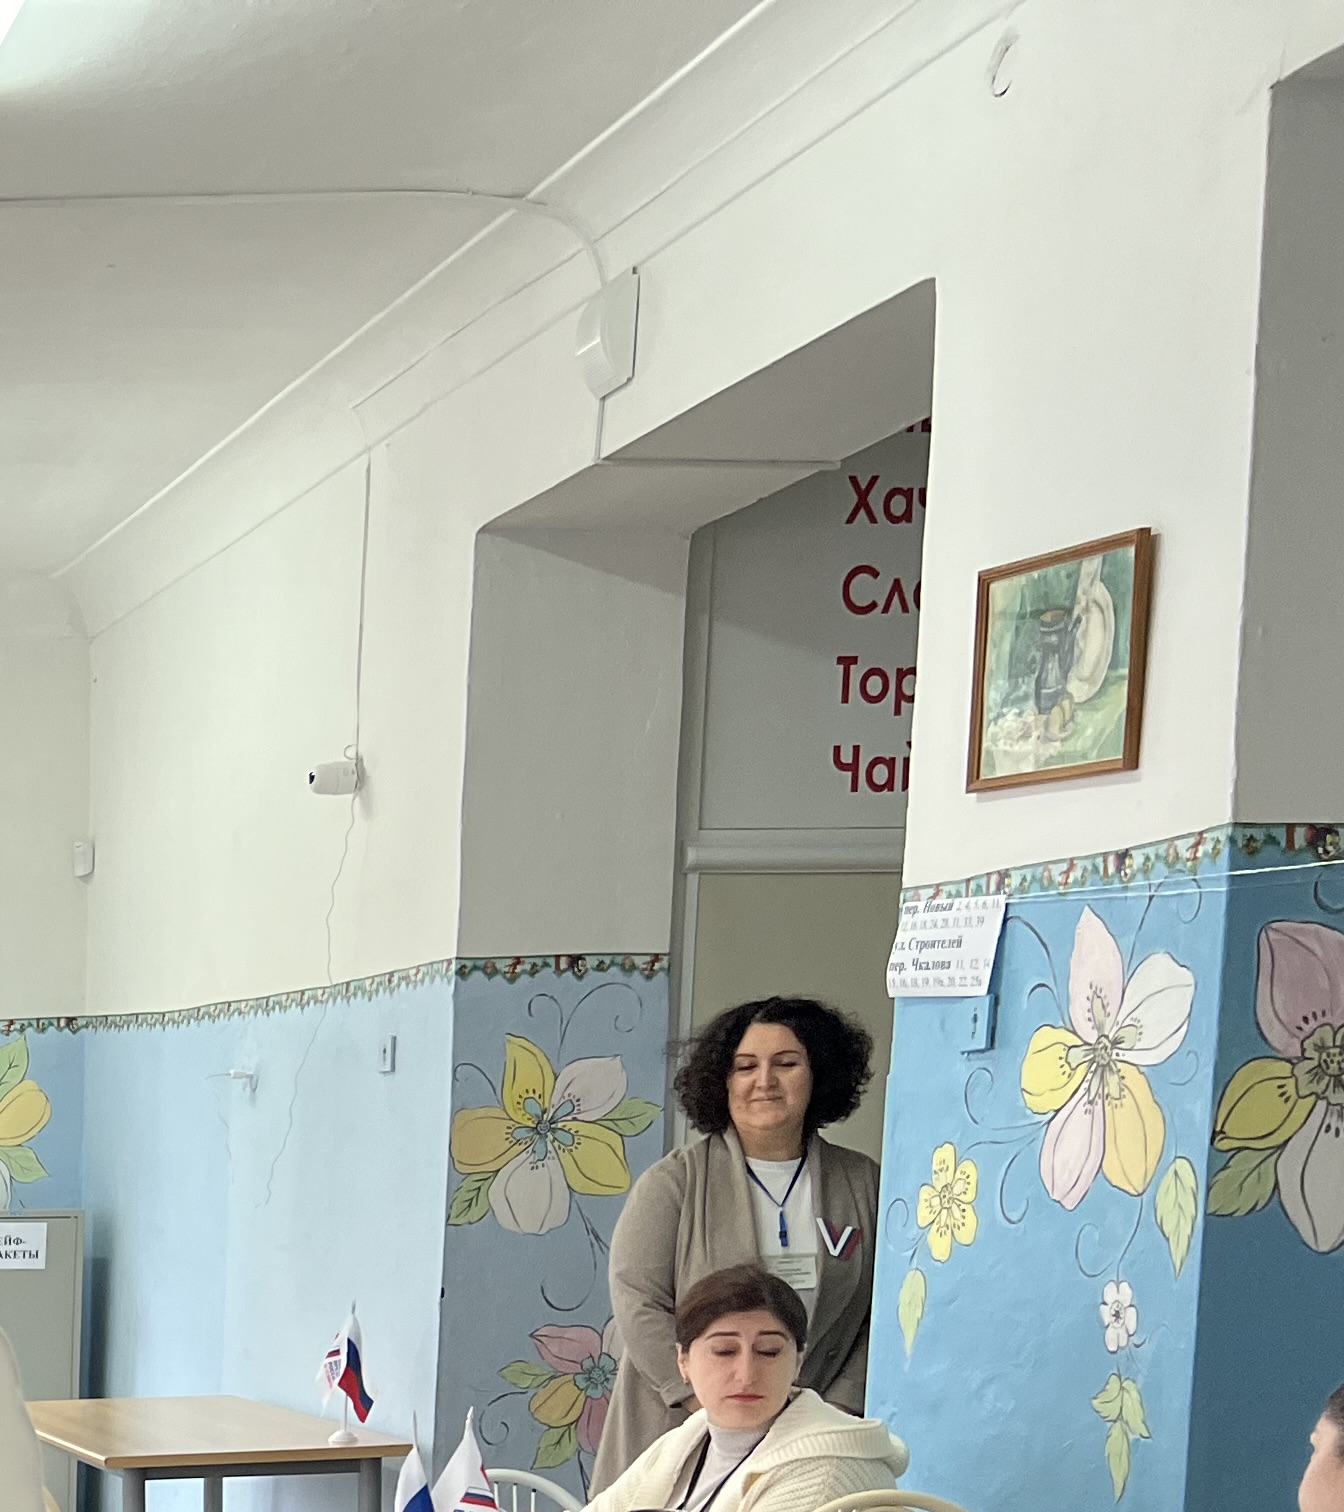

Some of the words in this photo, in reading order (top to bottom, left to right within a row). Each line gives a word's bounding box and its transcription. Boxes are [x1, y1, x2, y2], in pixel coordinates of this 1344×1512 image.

[923, 899, 954, 914] Новый
[909, 935, 963, 954] Строителей
[912, 958, 951, 971] Чкалова
